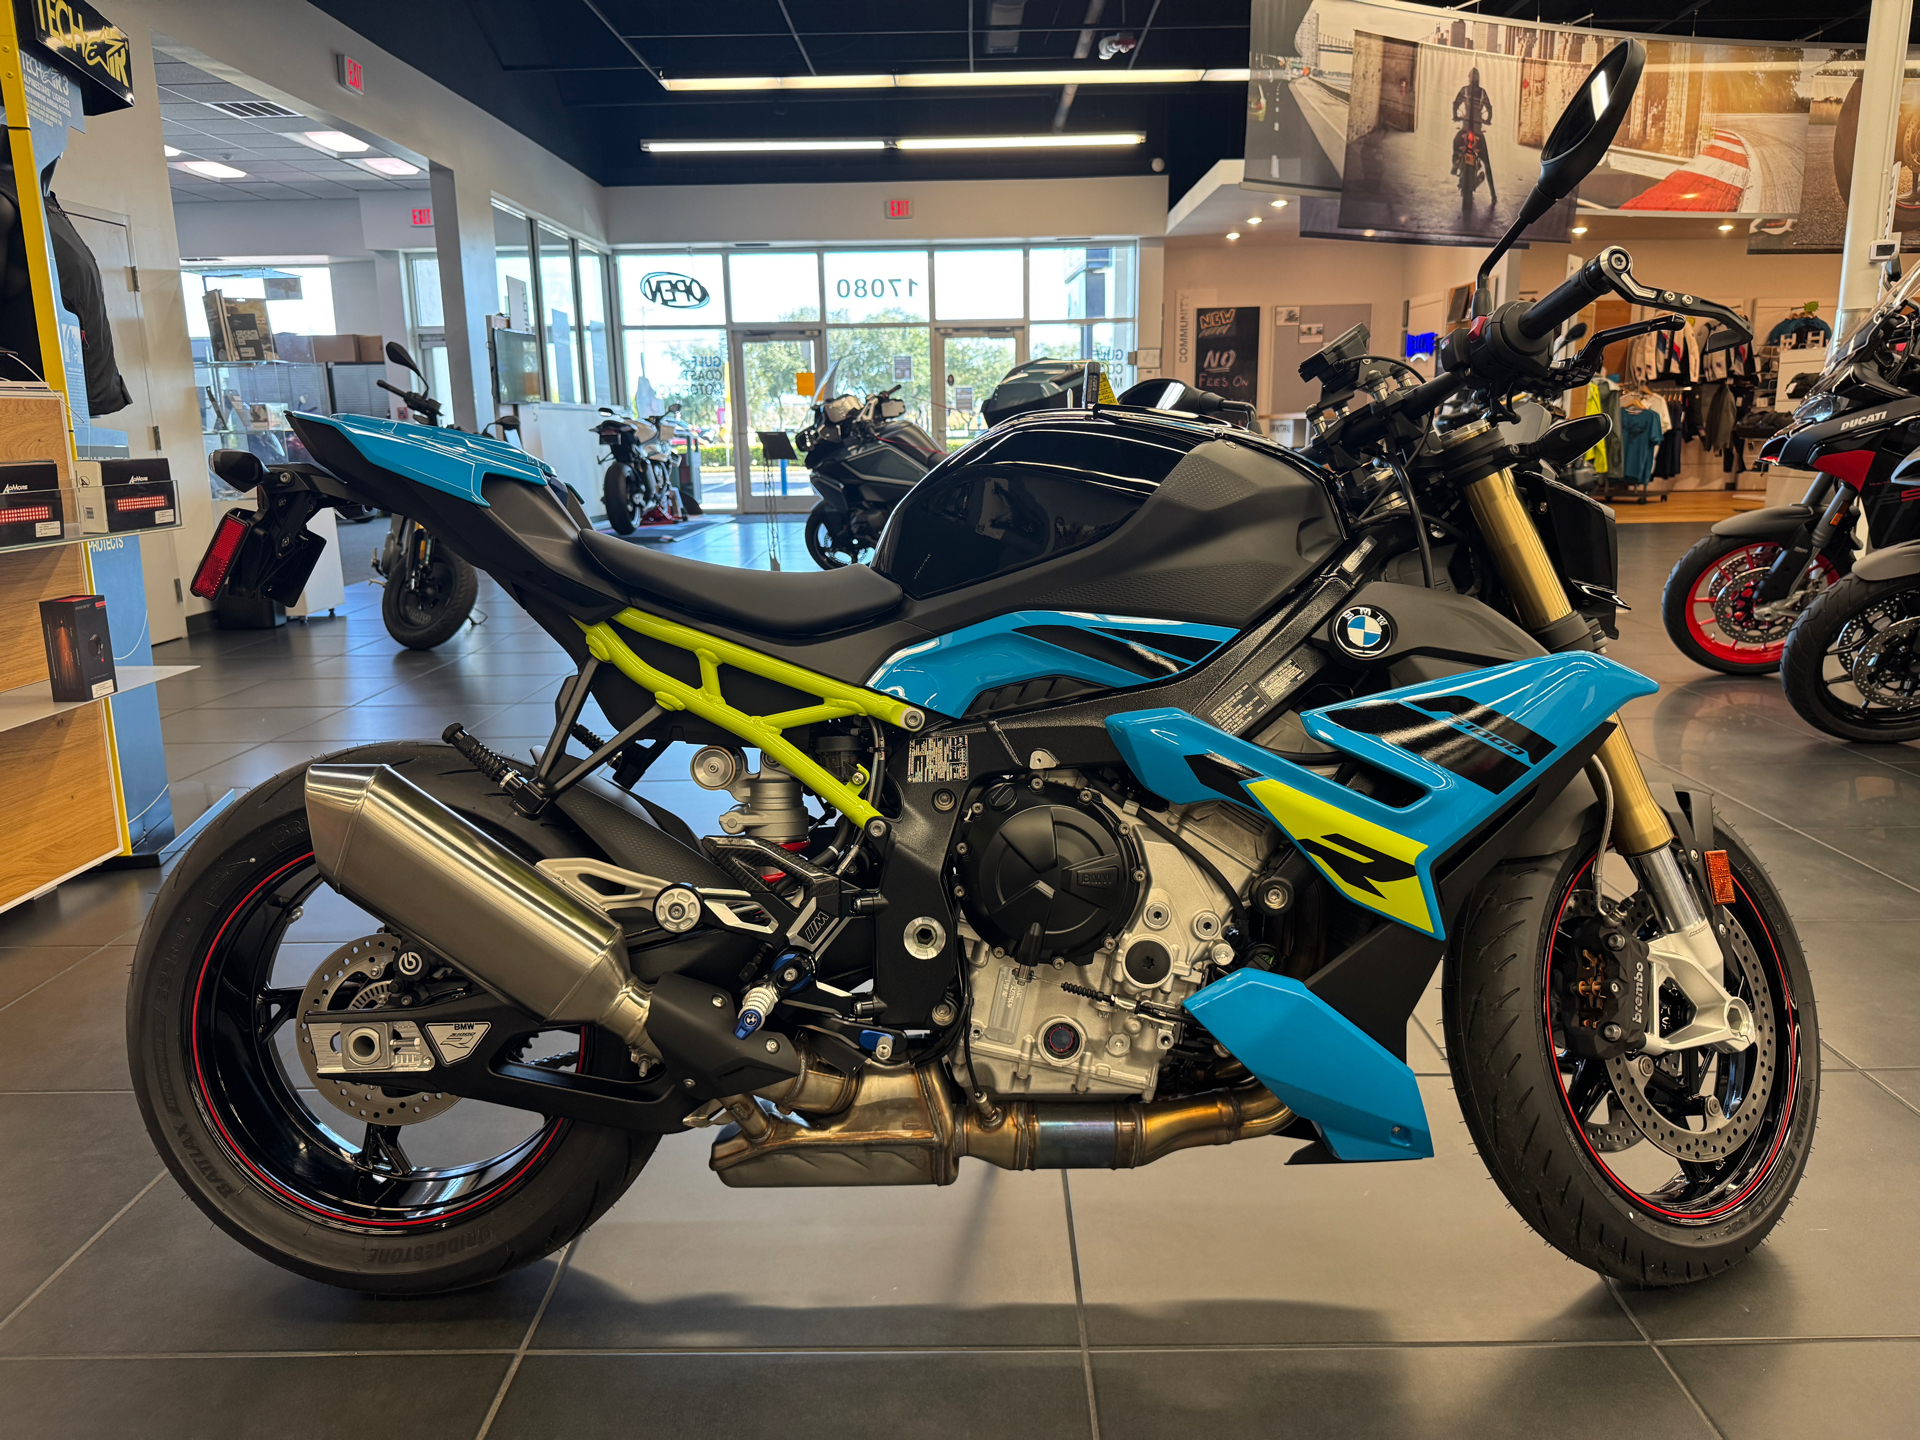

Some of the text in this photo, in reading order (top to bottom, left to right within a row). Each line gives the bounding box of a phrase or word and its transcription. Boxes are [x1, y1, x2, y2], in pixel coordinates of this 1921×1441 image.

[347, 58, 362, 91] EXIT
[62, 75, 70, 96] 3
[412, 208, 431, 225] EXIT
[890, 200, 909, 217] EXIT
[1179, 293, 1189, 364] COMMUNITY
[1199, 308, 1236, 329] NEW
[1203, 349, 1237, 369] NO
[1841, 411, 1888, 431] DUCATI
[88, 537, 125, 553] PROTECTS
[1342, 607, 1388, 627] BMW
[1082, 873, 1112, 884] BMW
[1632, 961, 1643, 1024] brembo
[453, 1023, 475, 1031] BMW
[1761, 1157, 1794, 1207] HYPERSPORT
[366, 1222, 495, 1264] BRIDGESTONE
